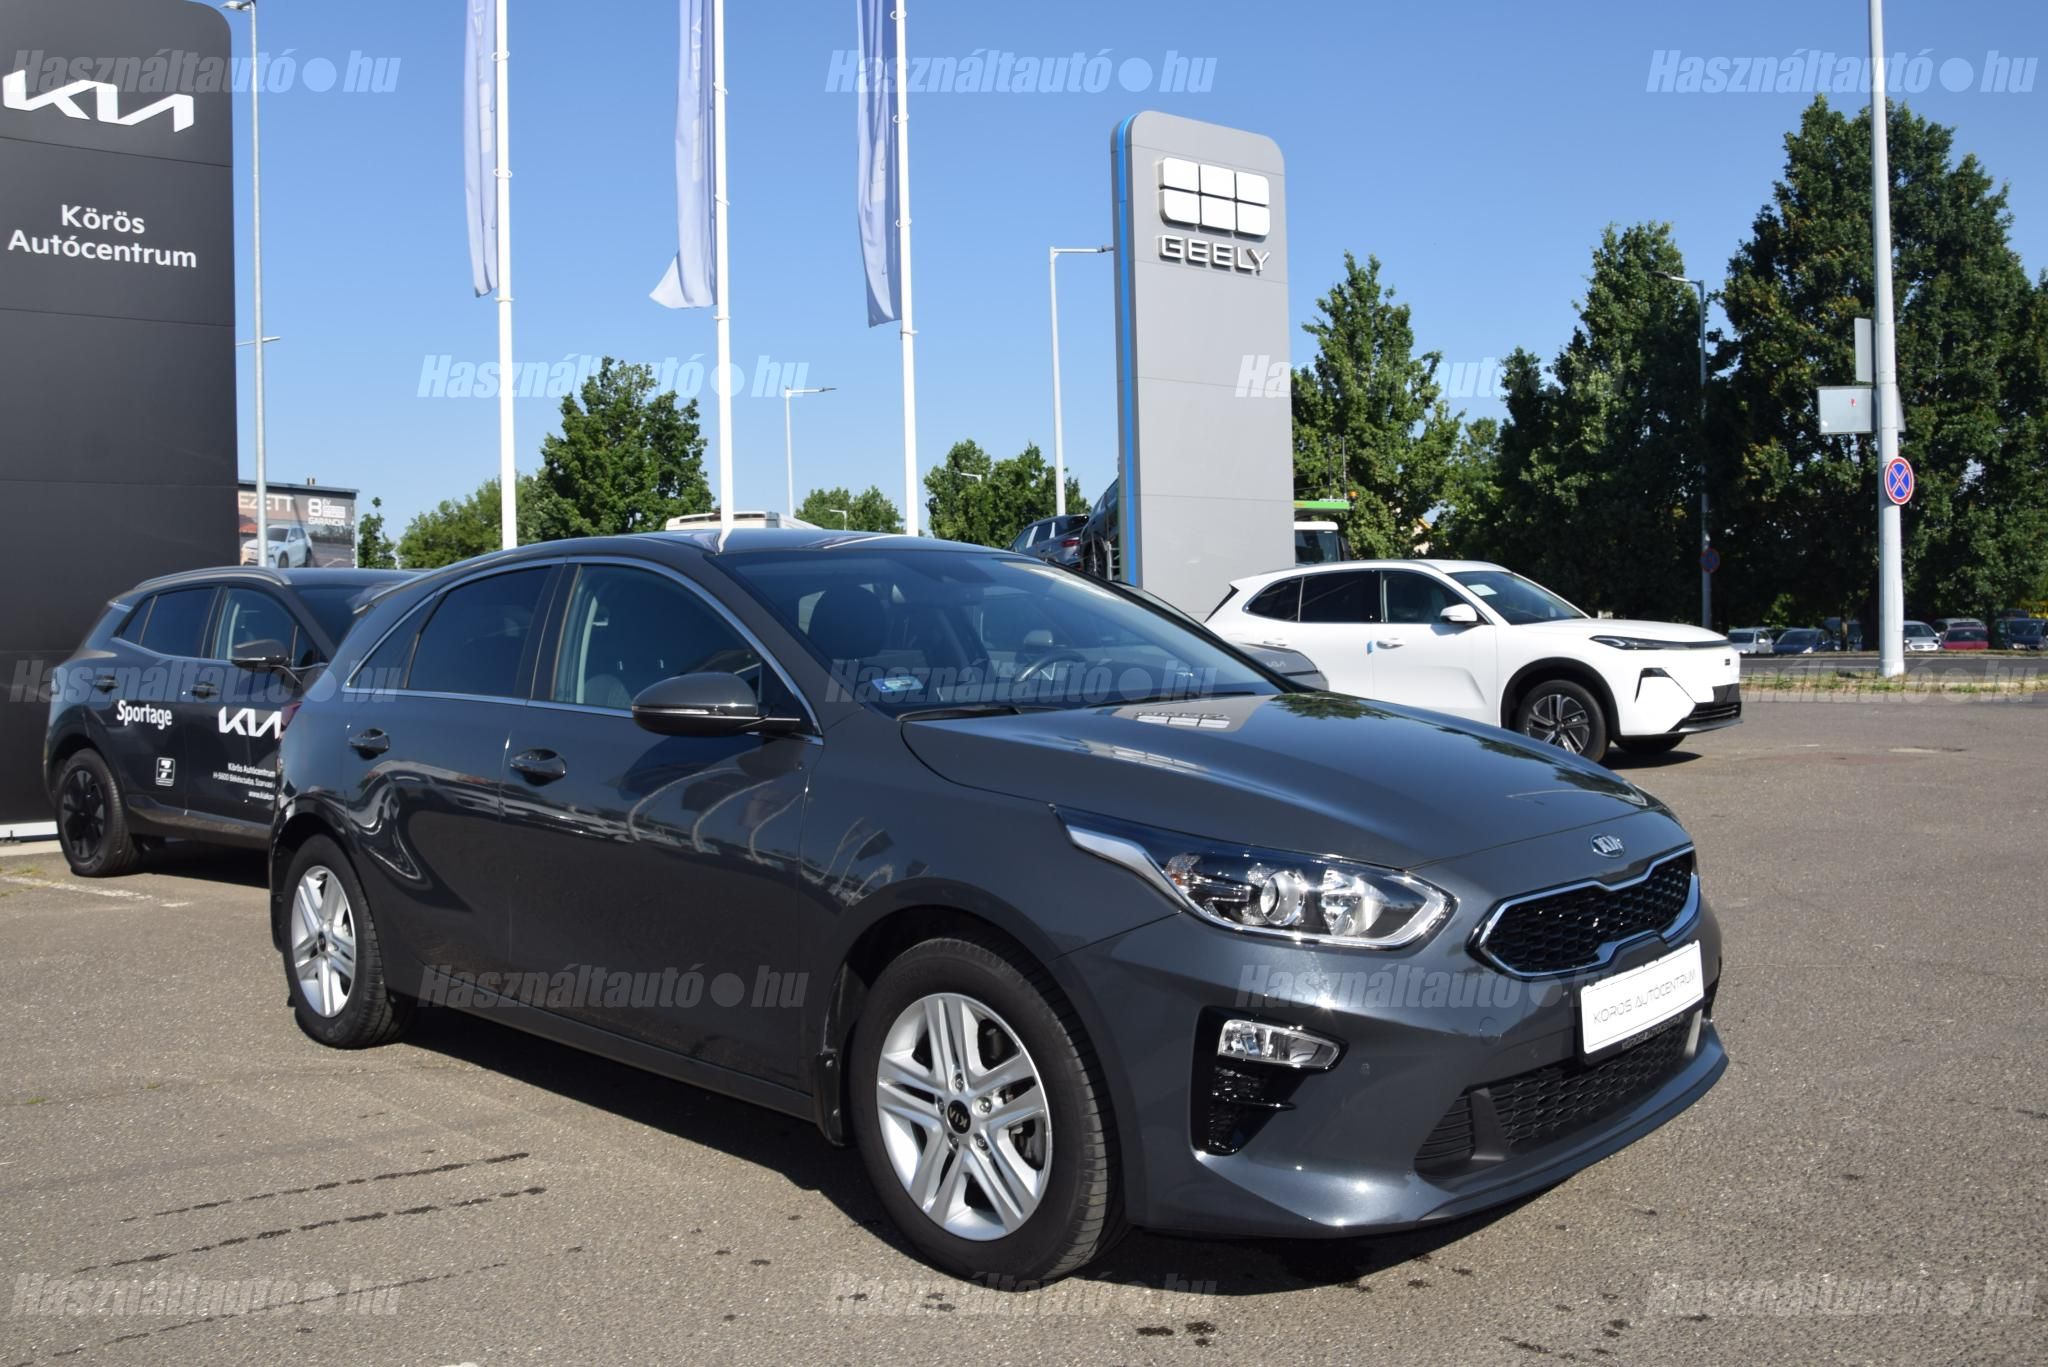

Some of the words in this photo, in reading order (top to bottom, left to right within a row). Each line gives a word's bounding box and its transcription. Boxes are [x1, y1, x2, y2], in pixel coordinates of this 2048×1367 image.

[61, 204, 145, 234] Körös
[8, 229, 197, 268] Autócentrum
[1160, 234, 1270, 273] GEELY
[116, 700, 173, 730] Sportage
